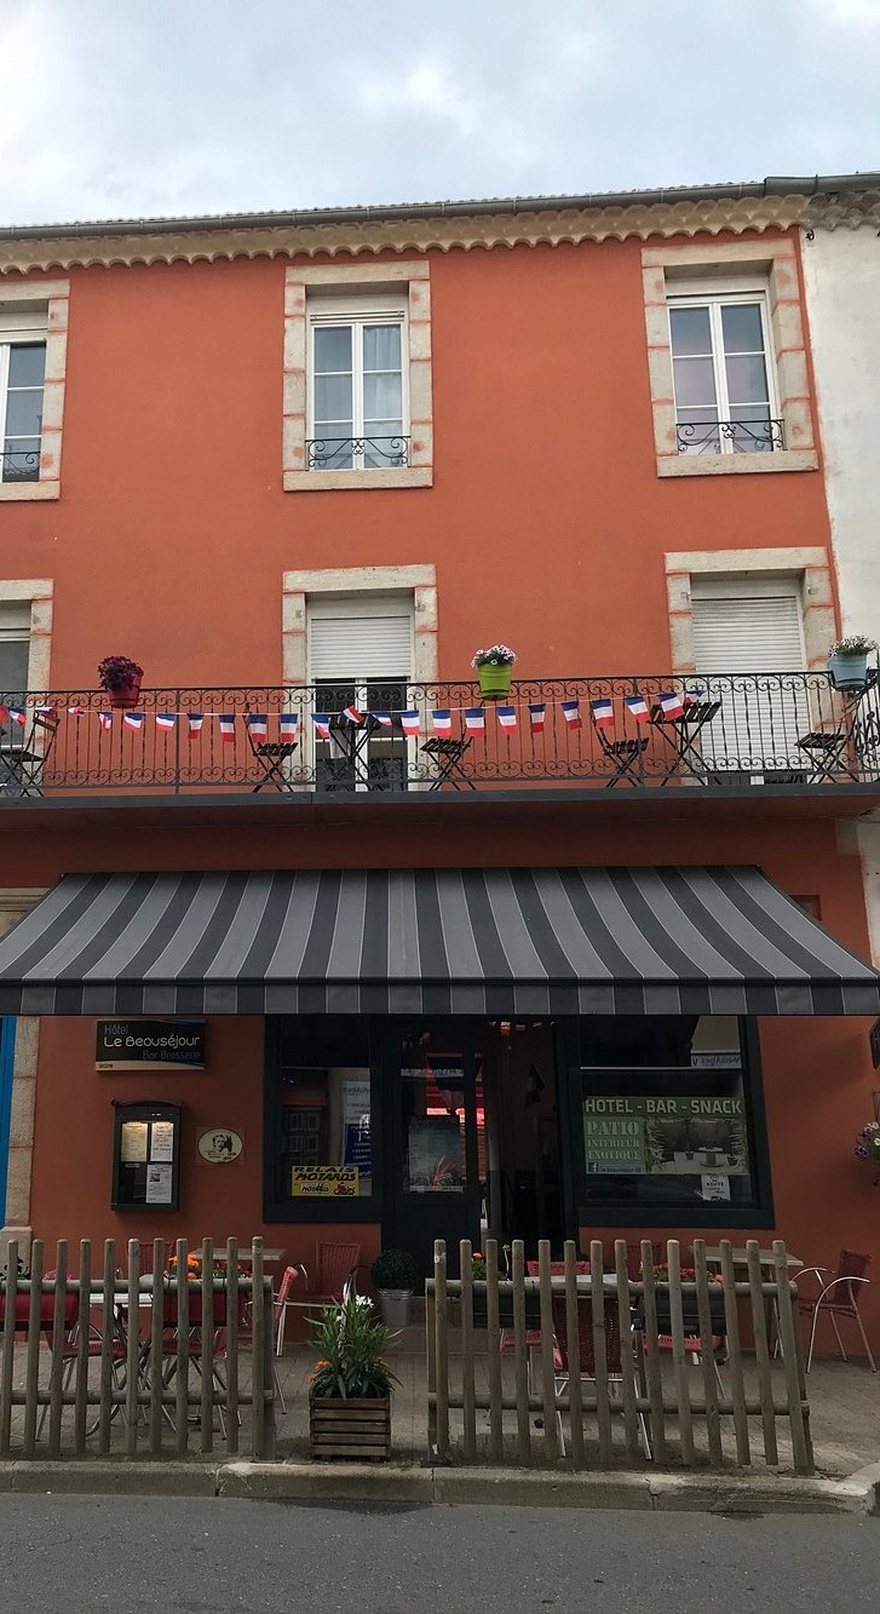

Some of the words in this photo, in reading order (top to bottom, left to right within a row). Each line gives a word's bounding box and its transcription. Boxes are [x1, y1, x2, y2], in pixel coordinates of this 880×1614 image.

[104, 1024, 129, 1035] Hôtel
[104, 1036, 122, 1047] Le
[143, 1050, 157, 1060] Bar
[161, 1050, 201, 1060] Brasserie
[585, 1099, 633, 1113] HOTEL
[646, 1099, 677, 1113] BAR
[691, 1099, 742, 1114] SNACK
[587, 1121, 640, 1135] PATIO
[588, 1150, 640, 1161] EXOTIQUE
[295, 1173, 356, 1181] MOTARDS
